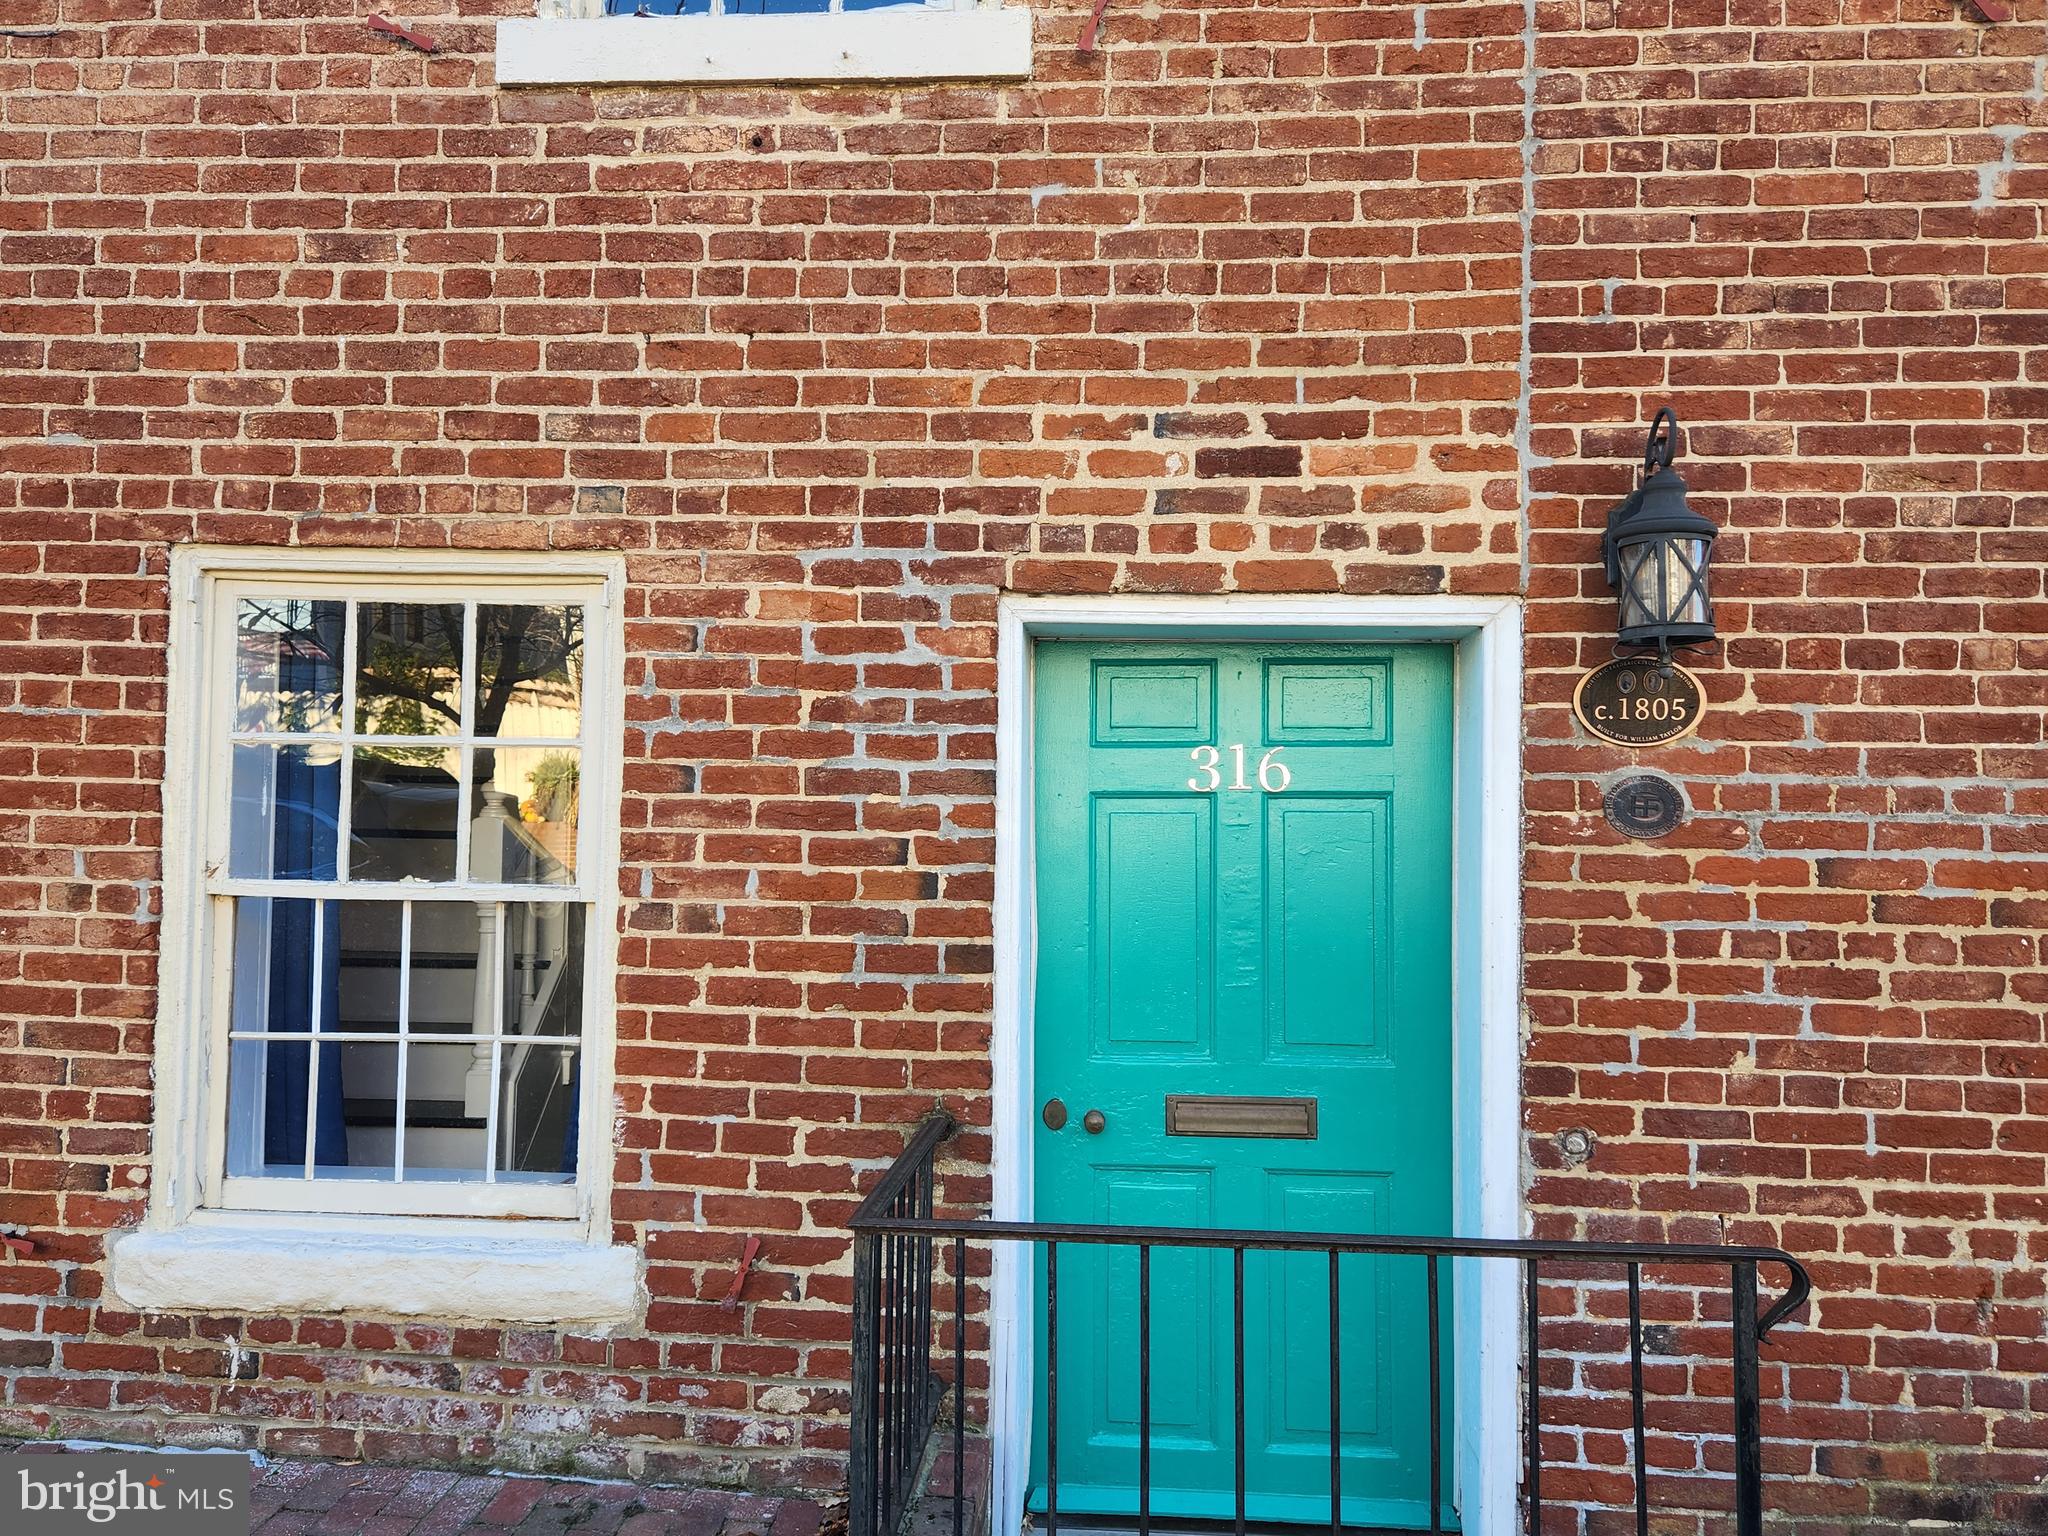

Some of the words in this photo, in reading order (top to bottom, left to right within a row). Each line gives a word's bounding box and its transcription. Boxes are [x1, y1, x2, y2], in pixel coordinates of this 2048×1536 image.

[1586, 667, 1609, 689] HISTORIC
[1596, 723, 1614, 736] BUILT
[1615, 733, 1628, 741] FOR
[1659, 724, 1683, 739] TAYLOR
[1187, 743, 1291, 793] 316
